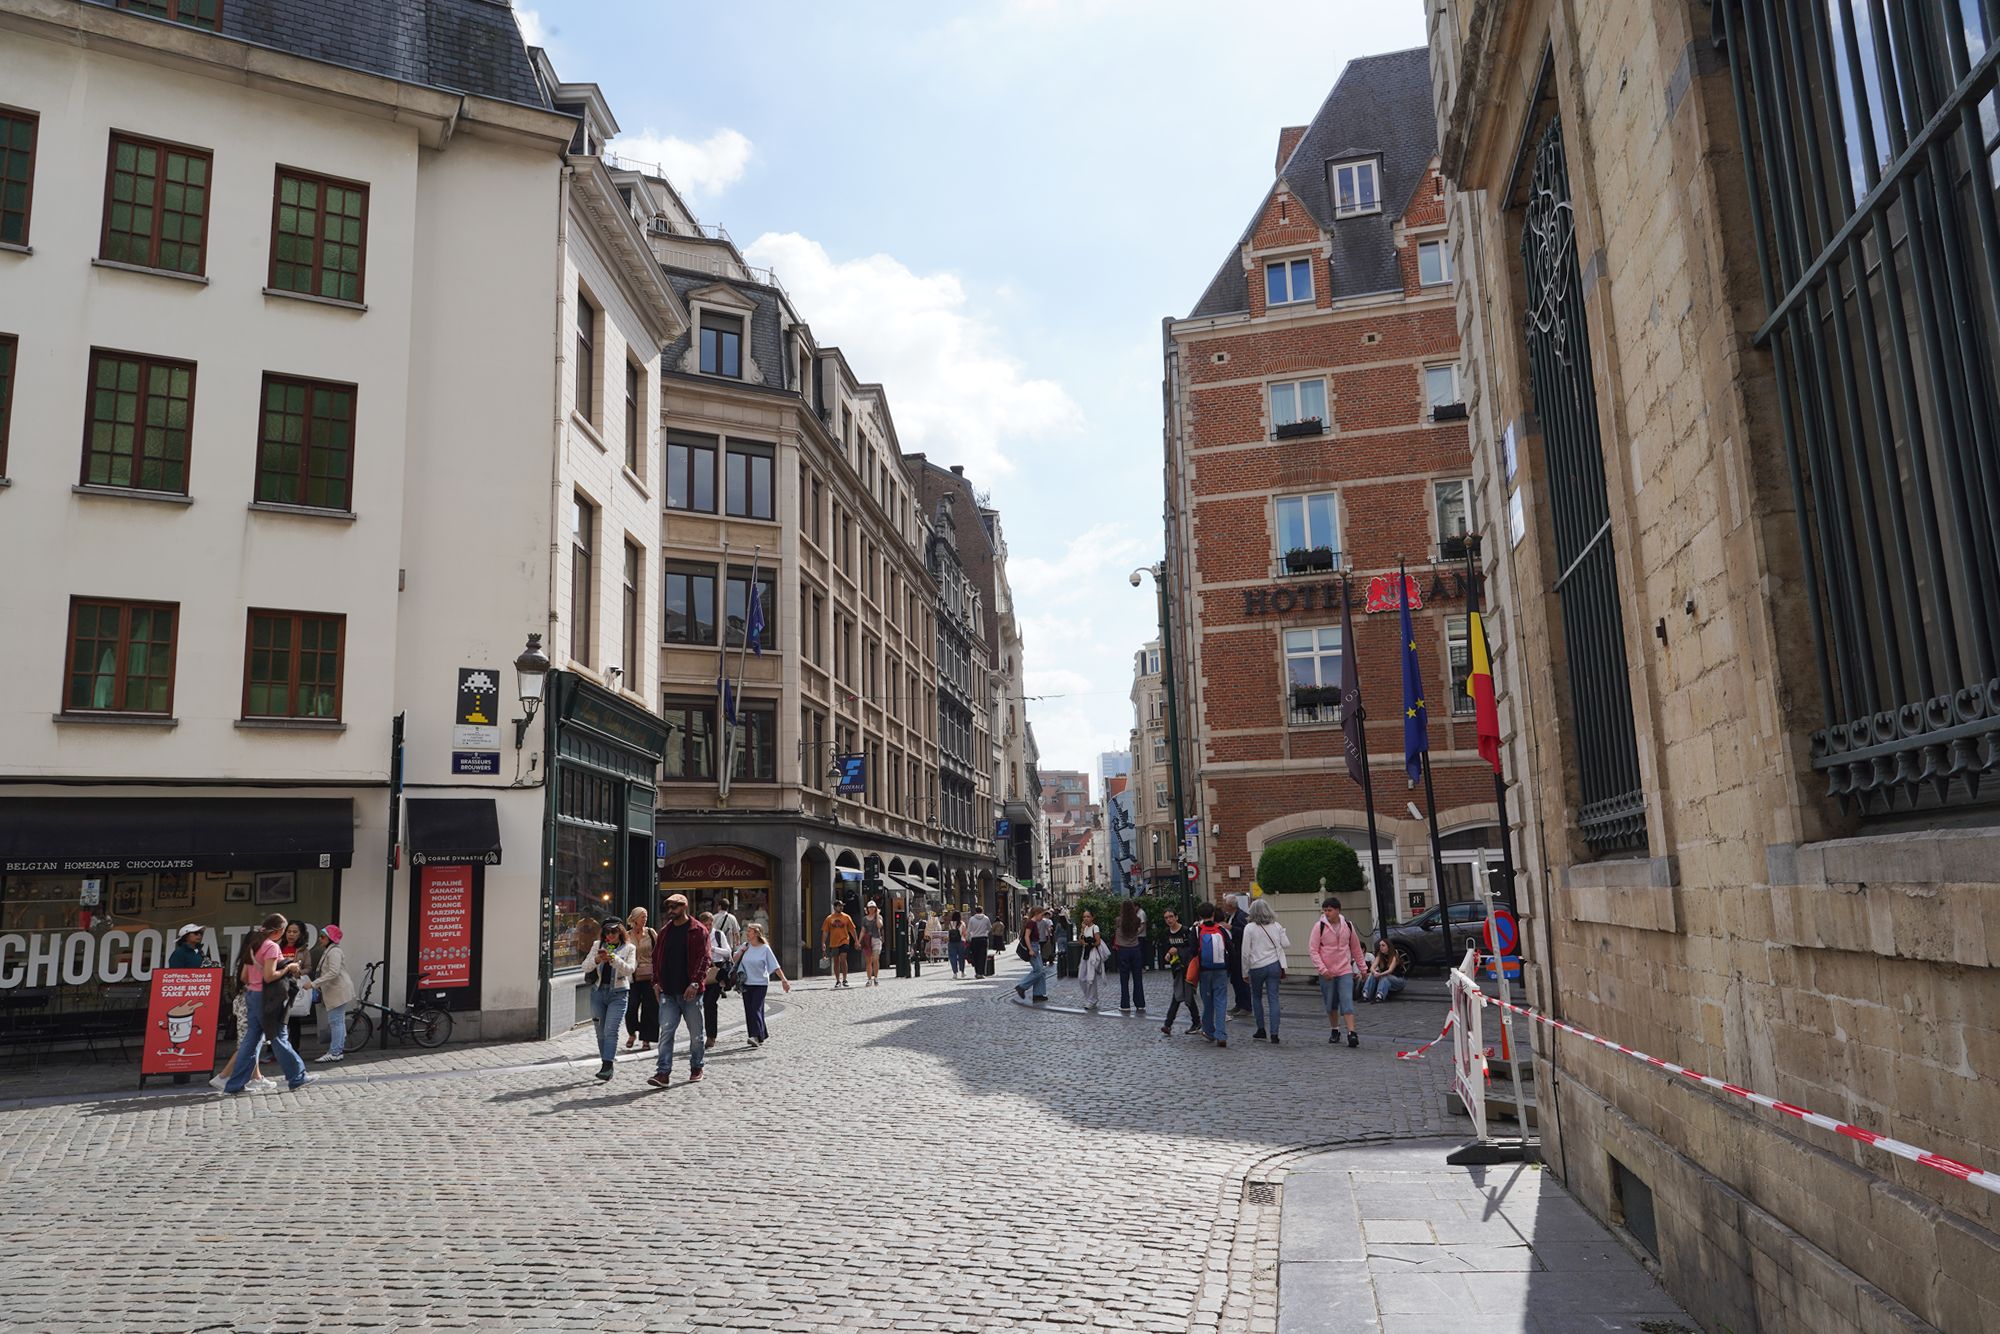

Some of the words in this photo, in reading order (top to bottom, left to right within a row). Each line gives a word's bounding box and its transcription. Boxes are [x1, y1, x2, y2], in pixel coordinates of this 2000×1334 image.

[6, 862, 57, 871] BELGIAN
[64, 861, 120, 870] HOMEMADE
[126, 860, 193, 869] CHOCOLATES
[672, 863, 705, 879] Lace
[708, 862, 752, 879] Palace
[428, 923, 463, 931] CARAMEL
